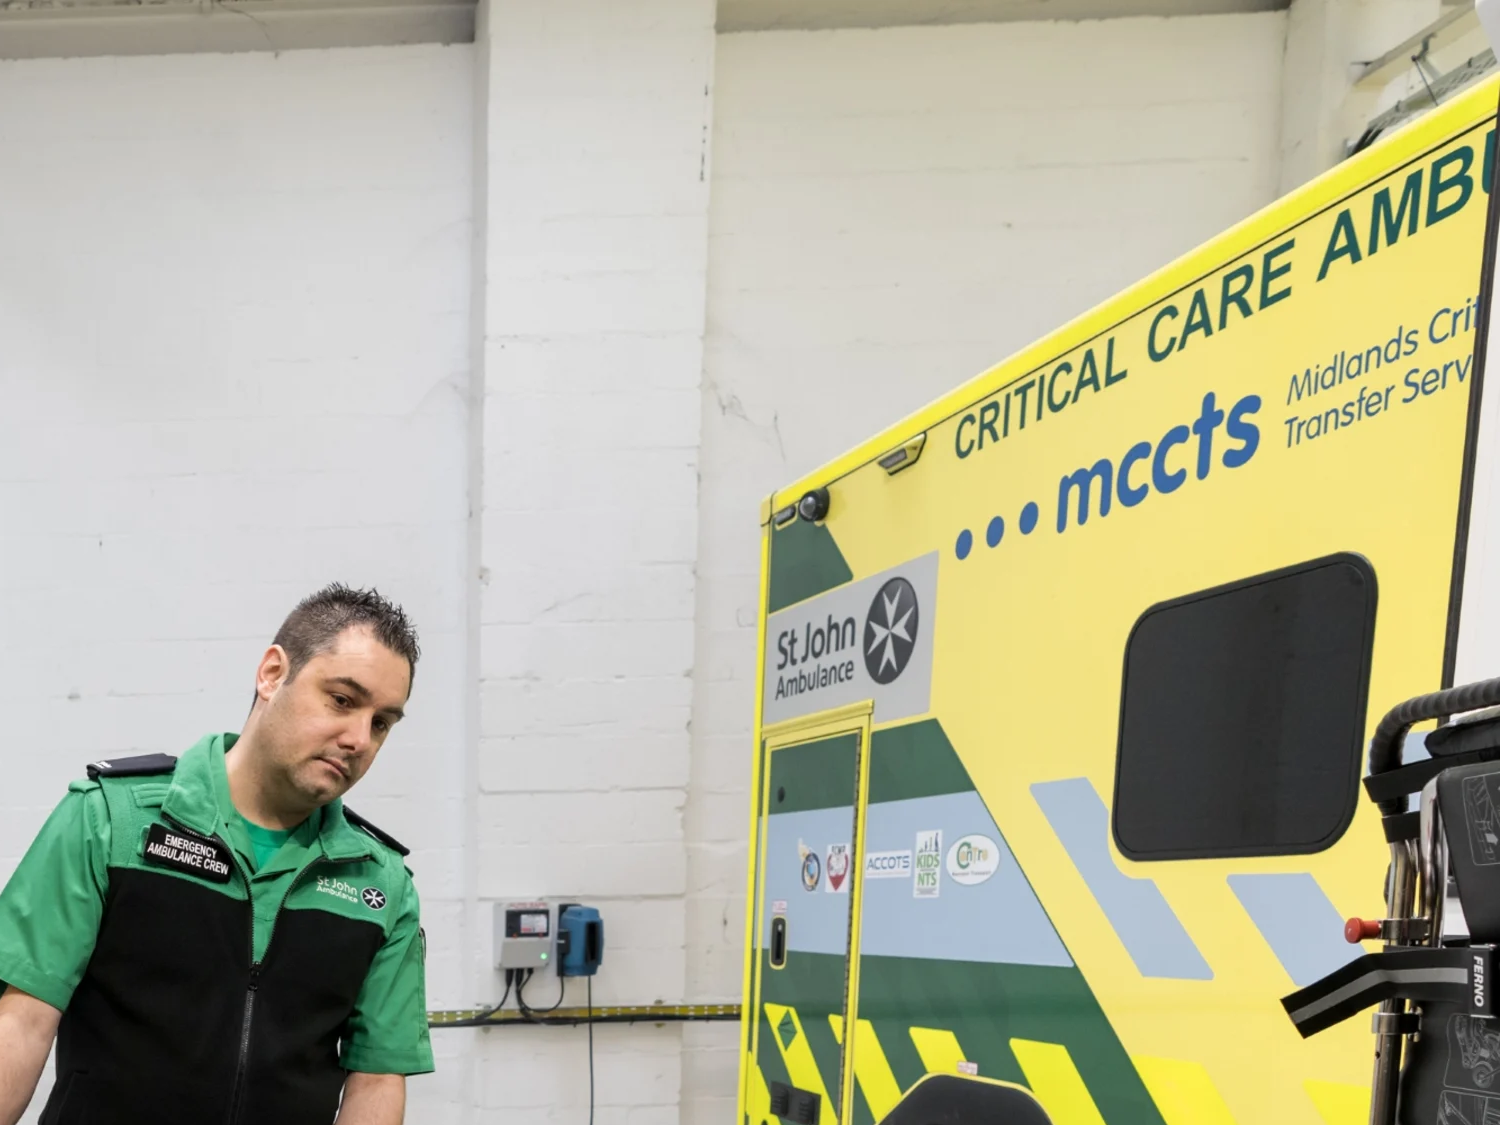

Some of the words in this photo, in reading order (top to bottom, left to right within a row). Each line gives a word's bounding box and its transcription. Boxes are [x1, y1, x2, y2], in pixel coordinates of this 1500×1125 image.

[955, 336, 1128, 459] CRITICAL
[1148, 238, 1295, 362] CARE
[1287, 325, 1419, 405] Midlands
[1284, 385, 1395, 448] Transfer
[1402, 354, 1473, 403] Serv
[1057, 392, 1262, 534] mccts
[777, 628, 798, 670] St
[801, 614, 856, 663] John
[775, 660, 854, 701] Ambulance
[146, 842, 203, 868] AMBULANCE
[203, 858, 230, 876] CREW
[164, 833, 218, 859] EMERGENCY
[866, 855, 910, 870] ACCOTS
[916, 853, 940, 869] KIDS
[316, 875, 330, 887] St
[331, 878, 358, 896] John
[316, 885, 359, 903] Ambulance
[917, 872, 937, 886] NTS
[1473, 955, 1485, 1008] FERNO
